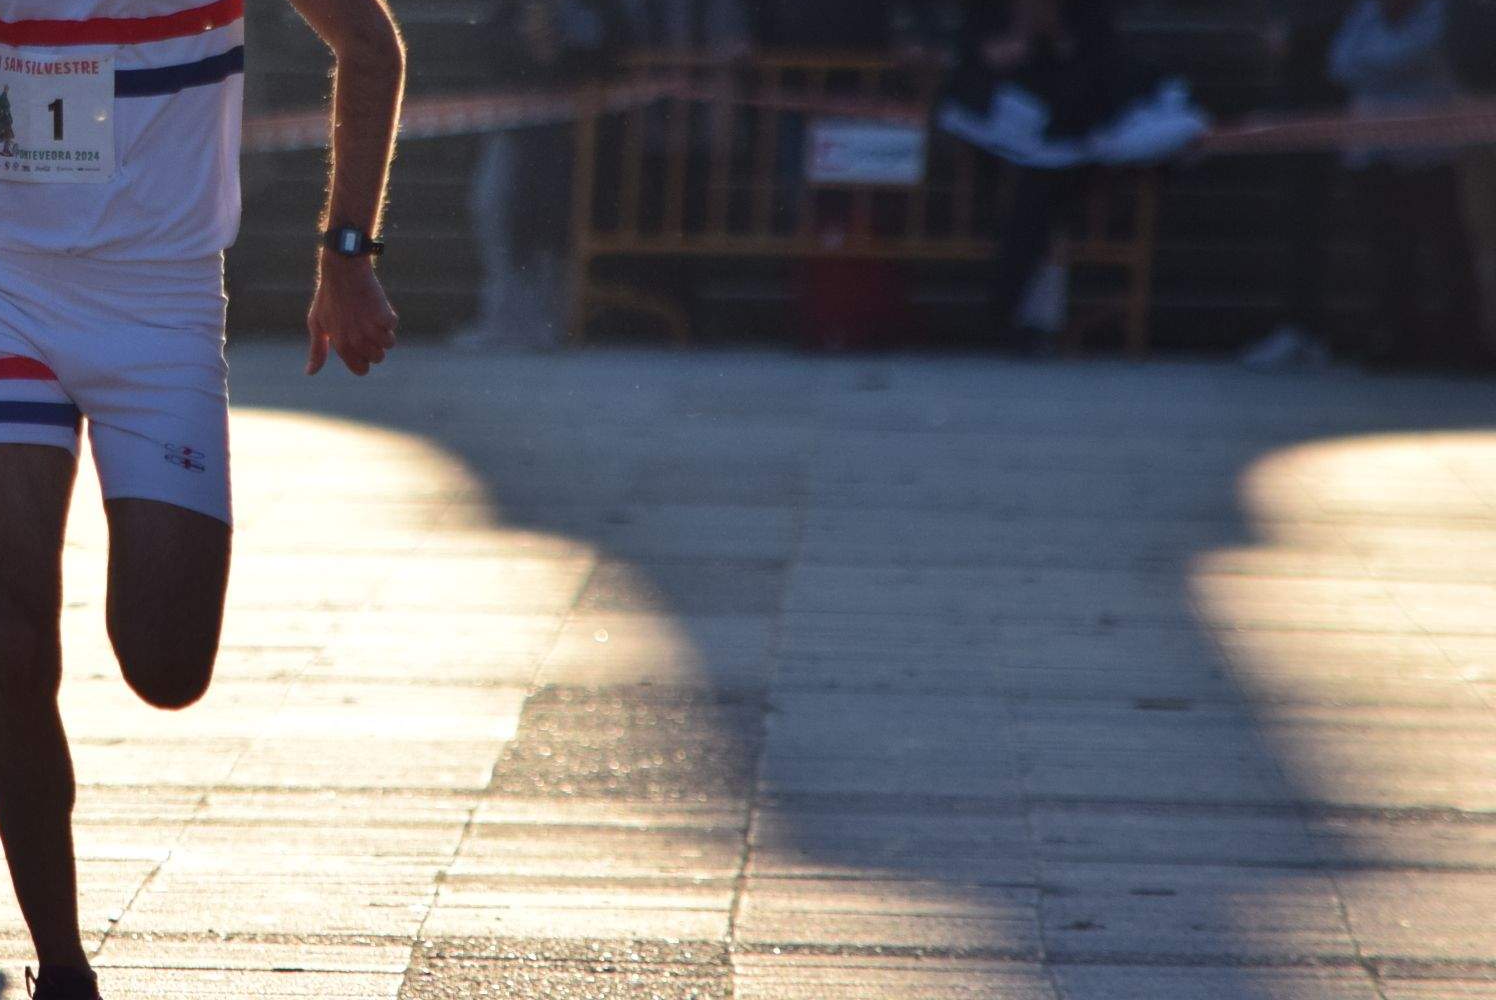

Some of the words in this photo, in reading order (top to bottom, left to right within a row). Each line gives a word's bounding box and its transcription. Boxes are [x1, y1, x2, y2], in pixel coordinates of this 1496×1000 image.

[4, 56, 23, 73] SAN
[25, 60, 100, 75] SILVESTRE
[48, 98, 64, 140] 1
[74, 151, 100, 161] 2024
